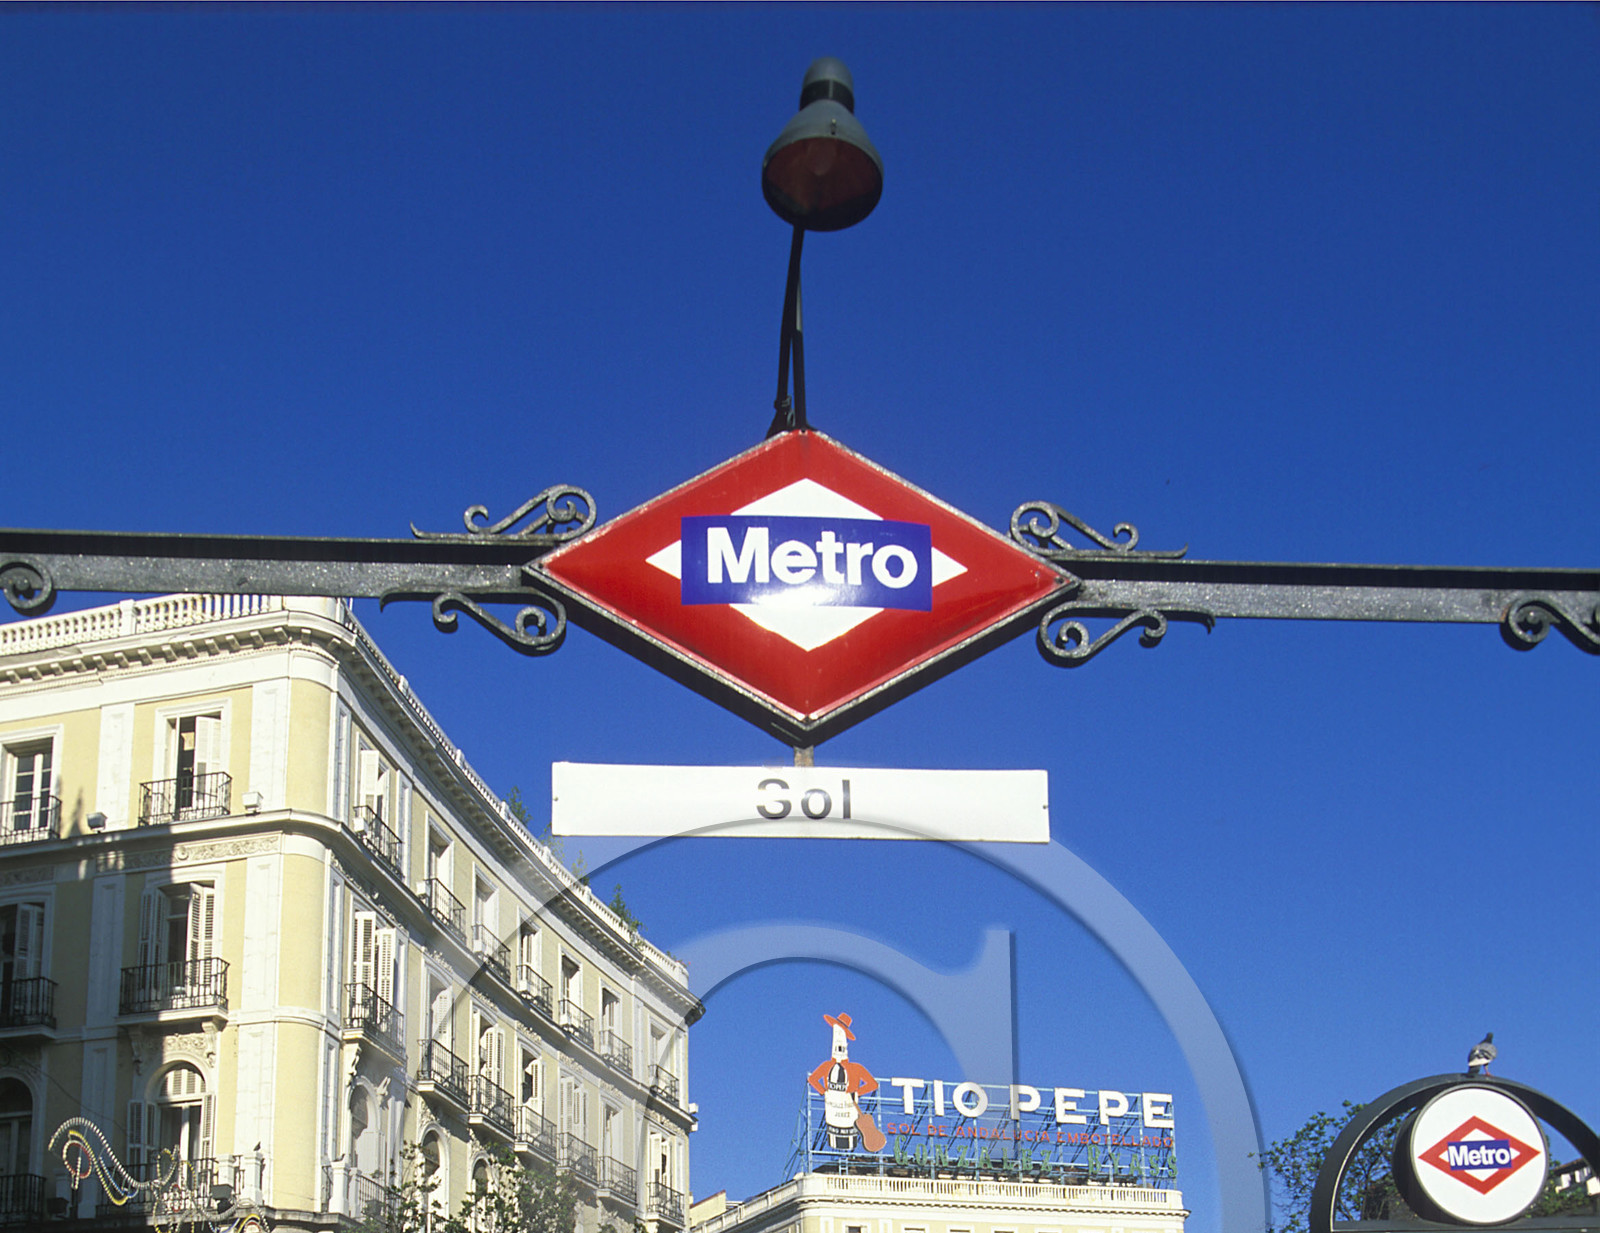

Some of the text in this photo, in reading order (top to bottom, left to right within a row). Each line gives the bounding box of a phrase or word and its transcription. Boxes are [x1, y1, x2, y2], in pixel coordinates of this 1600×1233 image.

[707, 526, 918, 589] Metro
[756, 778, 852, 821] Sol
[891, 1077, 1175, 1128] TIO PEPE
[887, 1122, 920, 1136] SOL
[927, 1125, 949, 1137] DE
[1057, 1132, 1173, 1148] EMBOTELLADO
[1087, 1144, 1178, 1177] BYASS
[1448, 1145, 1510, 1166] Metro
